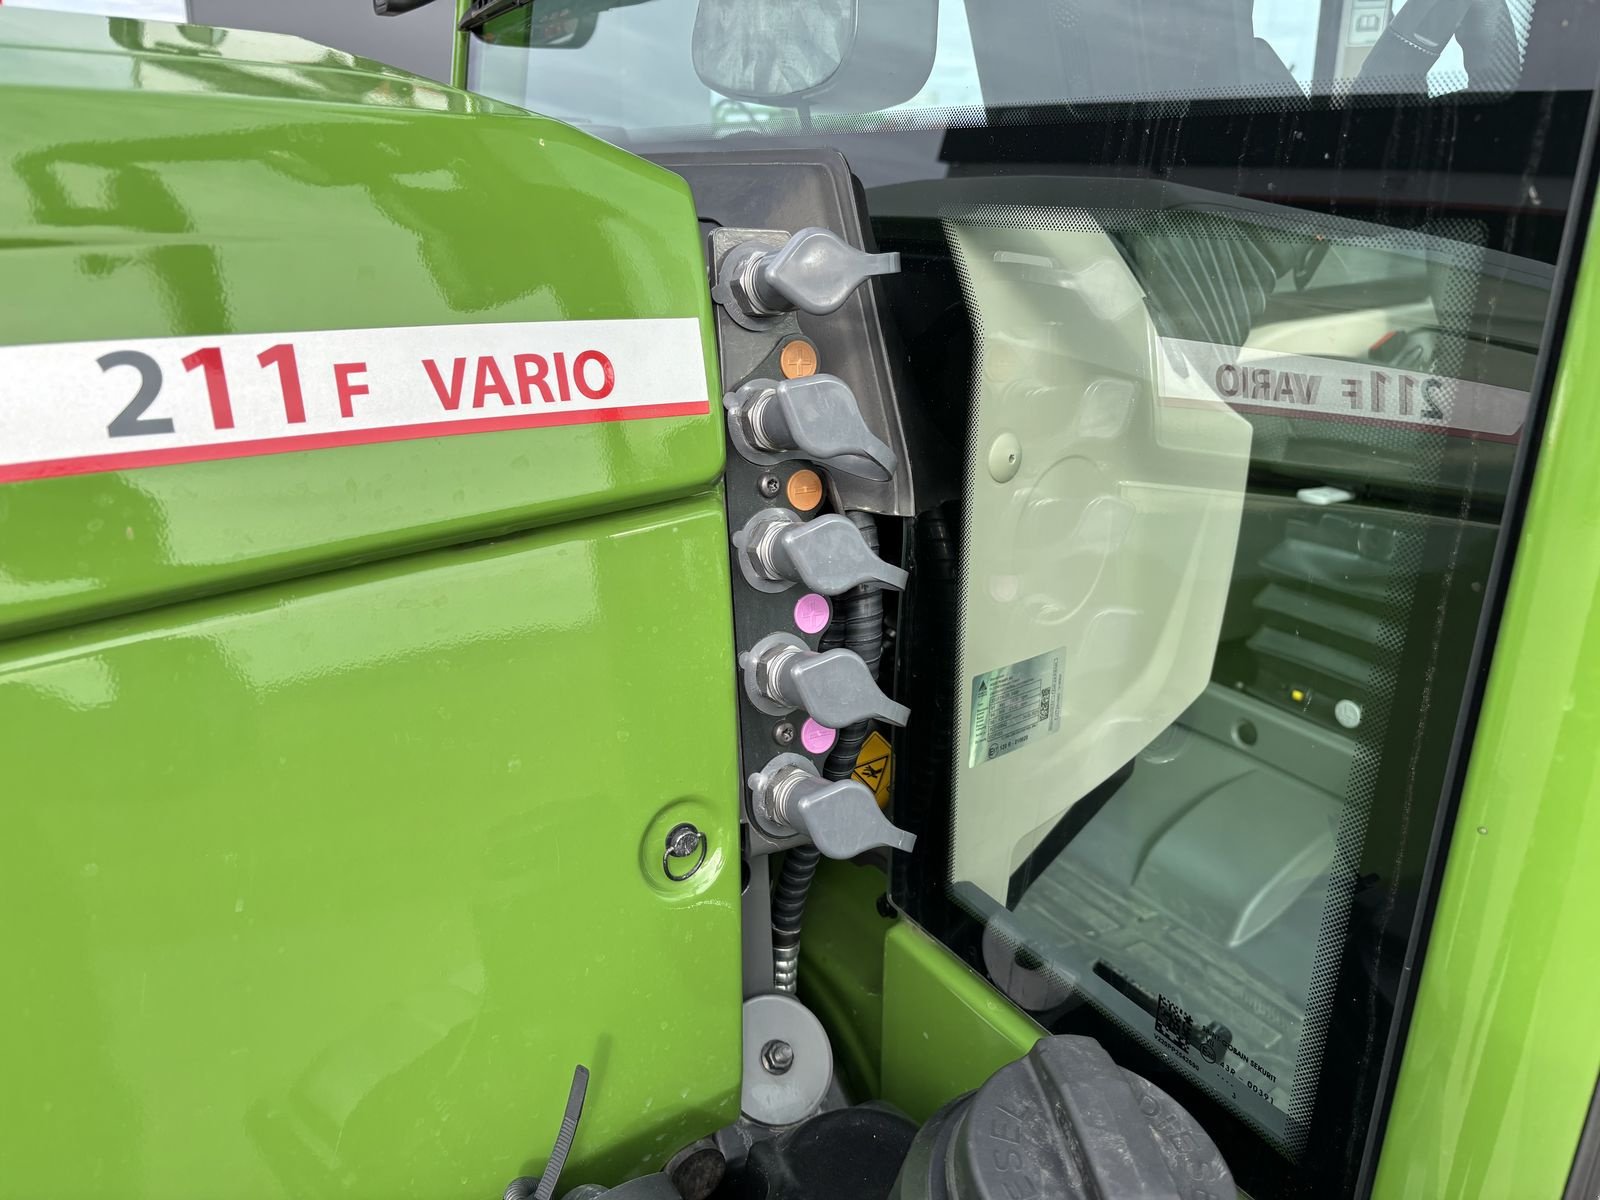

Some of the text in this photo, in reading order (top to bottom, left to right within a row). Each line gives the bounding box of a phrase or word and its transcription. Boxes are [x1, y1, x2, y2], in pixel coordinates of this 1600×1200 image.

[96, 343, 615, 438] 211 F VARIO
[1250, 1060, 1277, 1083] SEKURIT
